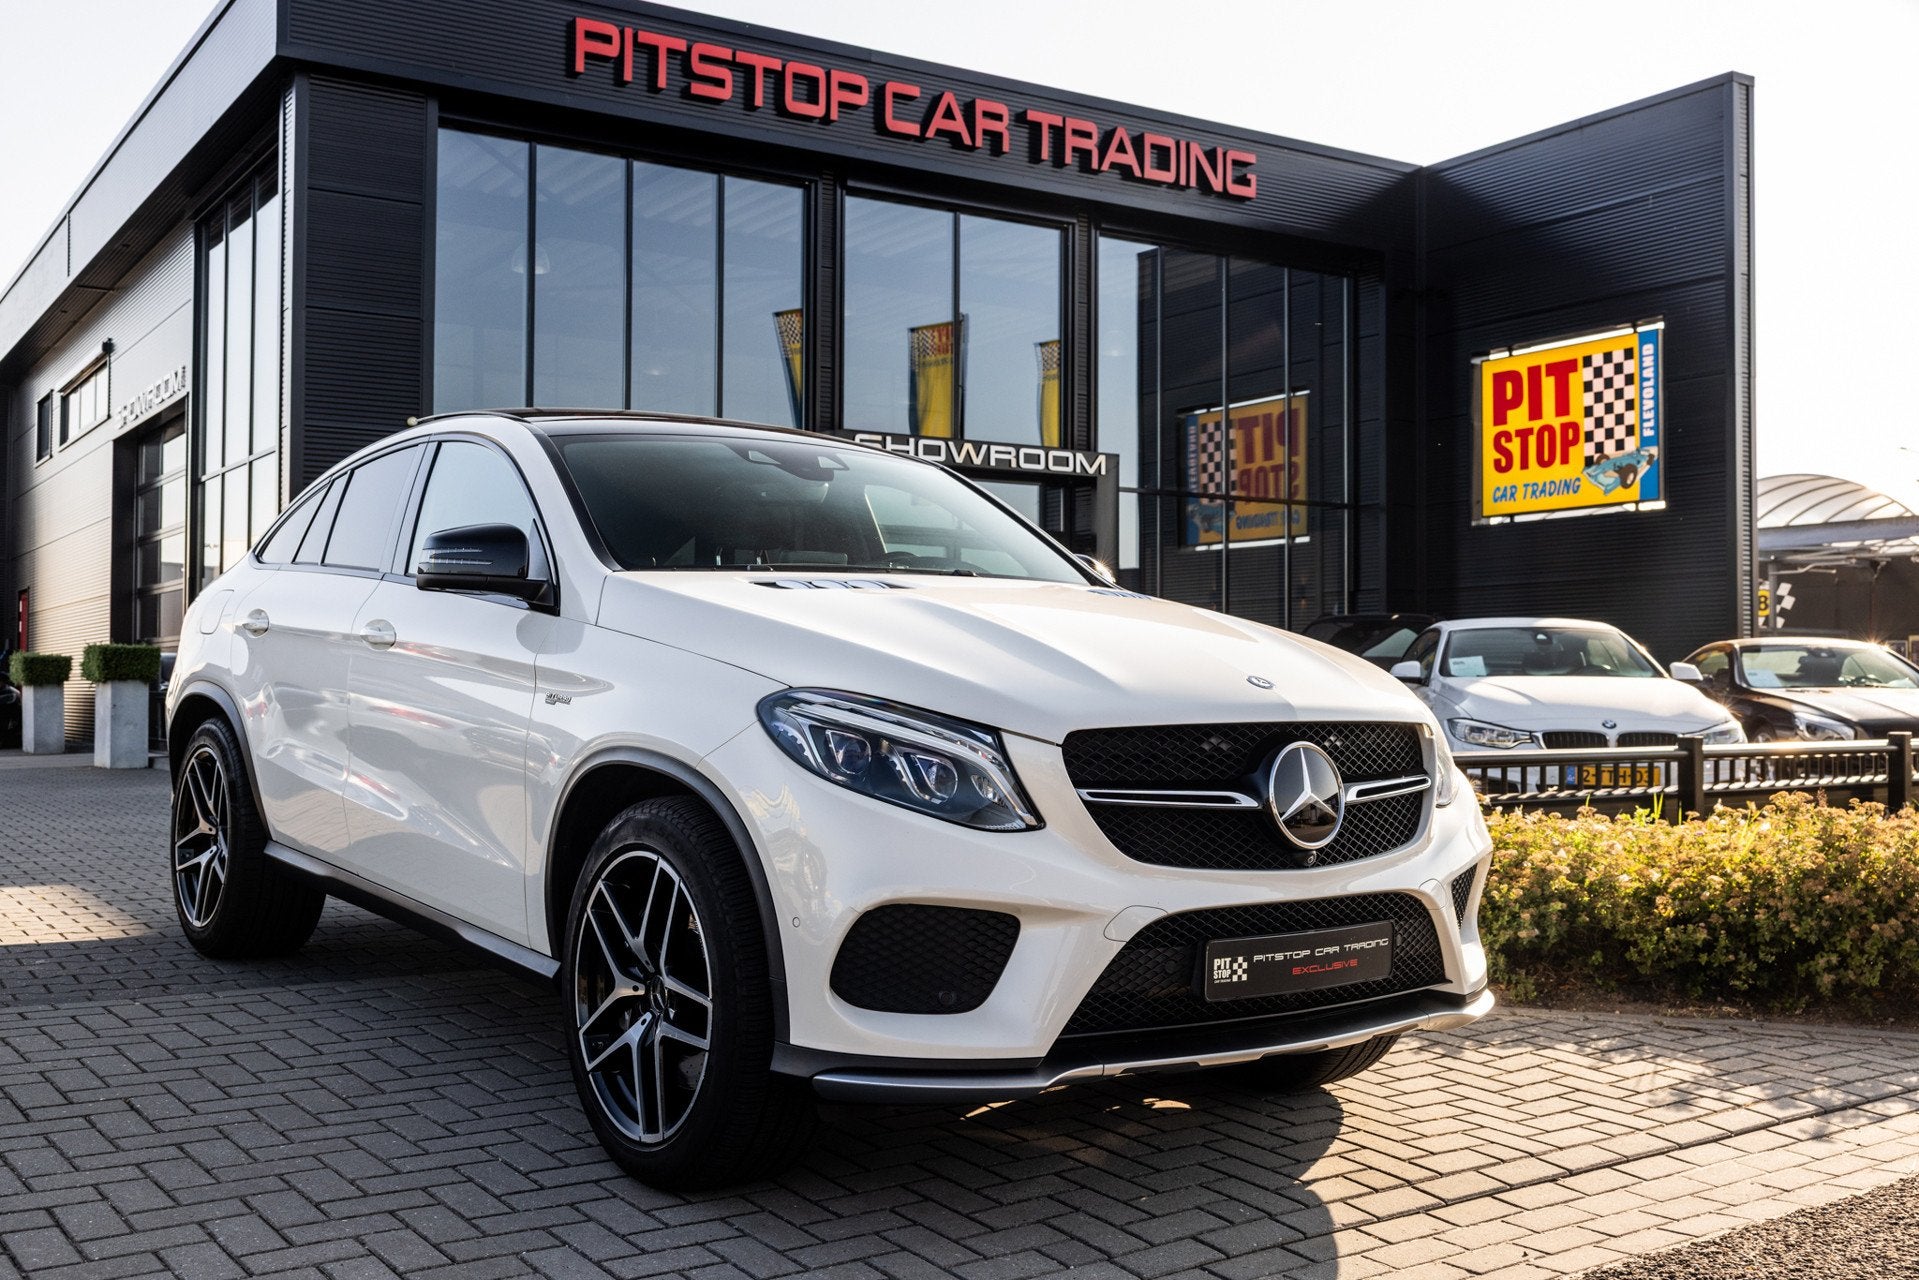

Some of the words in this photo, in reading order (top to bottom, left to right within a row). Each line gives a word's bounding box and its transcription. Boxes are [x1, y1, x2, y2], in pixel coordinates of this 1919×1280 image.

[574, 16, 870, 121] PITSTOP
[885, 81, 1010, 154] CAR
[1026, 109, 1257, 199] TRADING
[1492, 358, 1578, 427] PIT
[1642, 343, 1655, 437] FLEVOLAND
[855, 433, 1107, 476] SHOWROOM
[1493, 421, 1580, 474] STOP
[1493, 484, 1518, 503] CAR
[1523, 477, 1581, 500] TRADING
[1213, 957, 1231, 970] PIT
[1253, 950, 1311, 963] PITSTOP
[1315, 945, 1340, 956] CAR
[1344, 938, 1389, 952] TRADING
[1292, 959, 1358, 975] EXCLUSIVE
[1213, 969, 1231, 979] STOP
